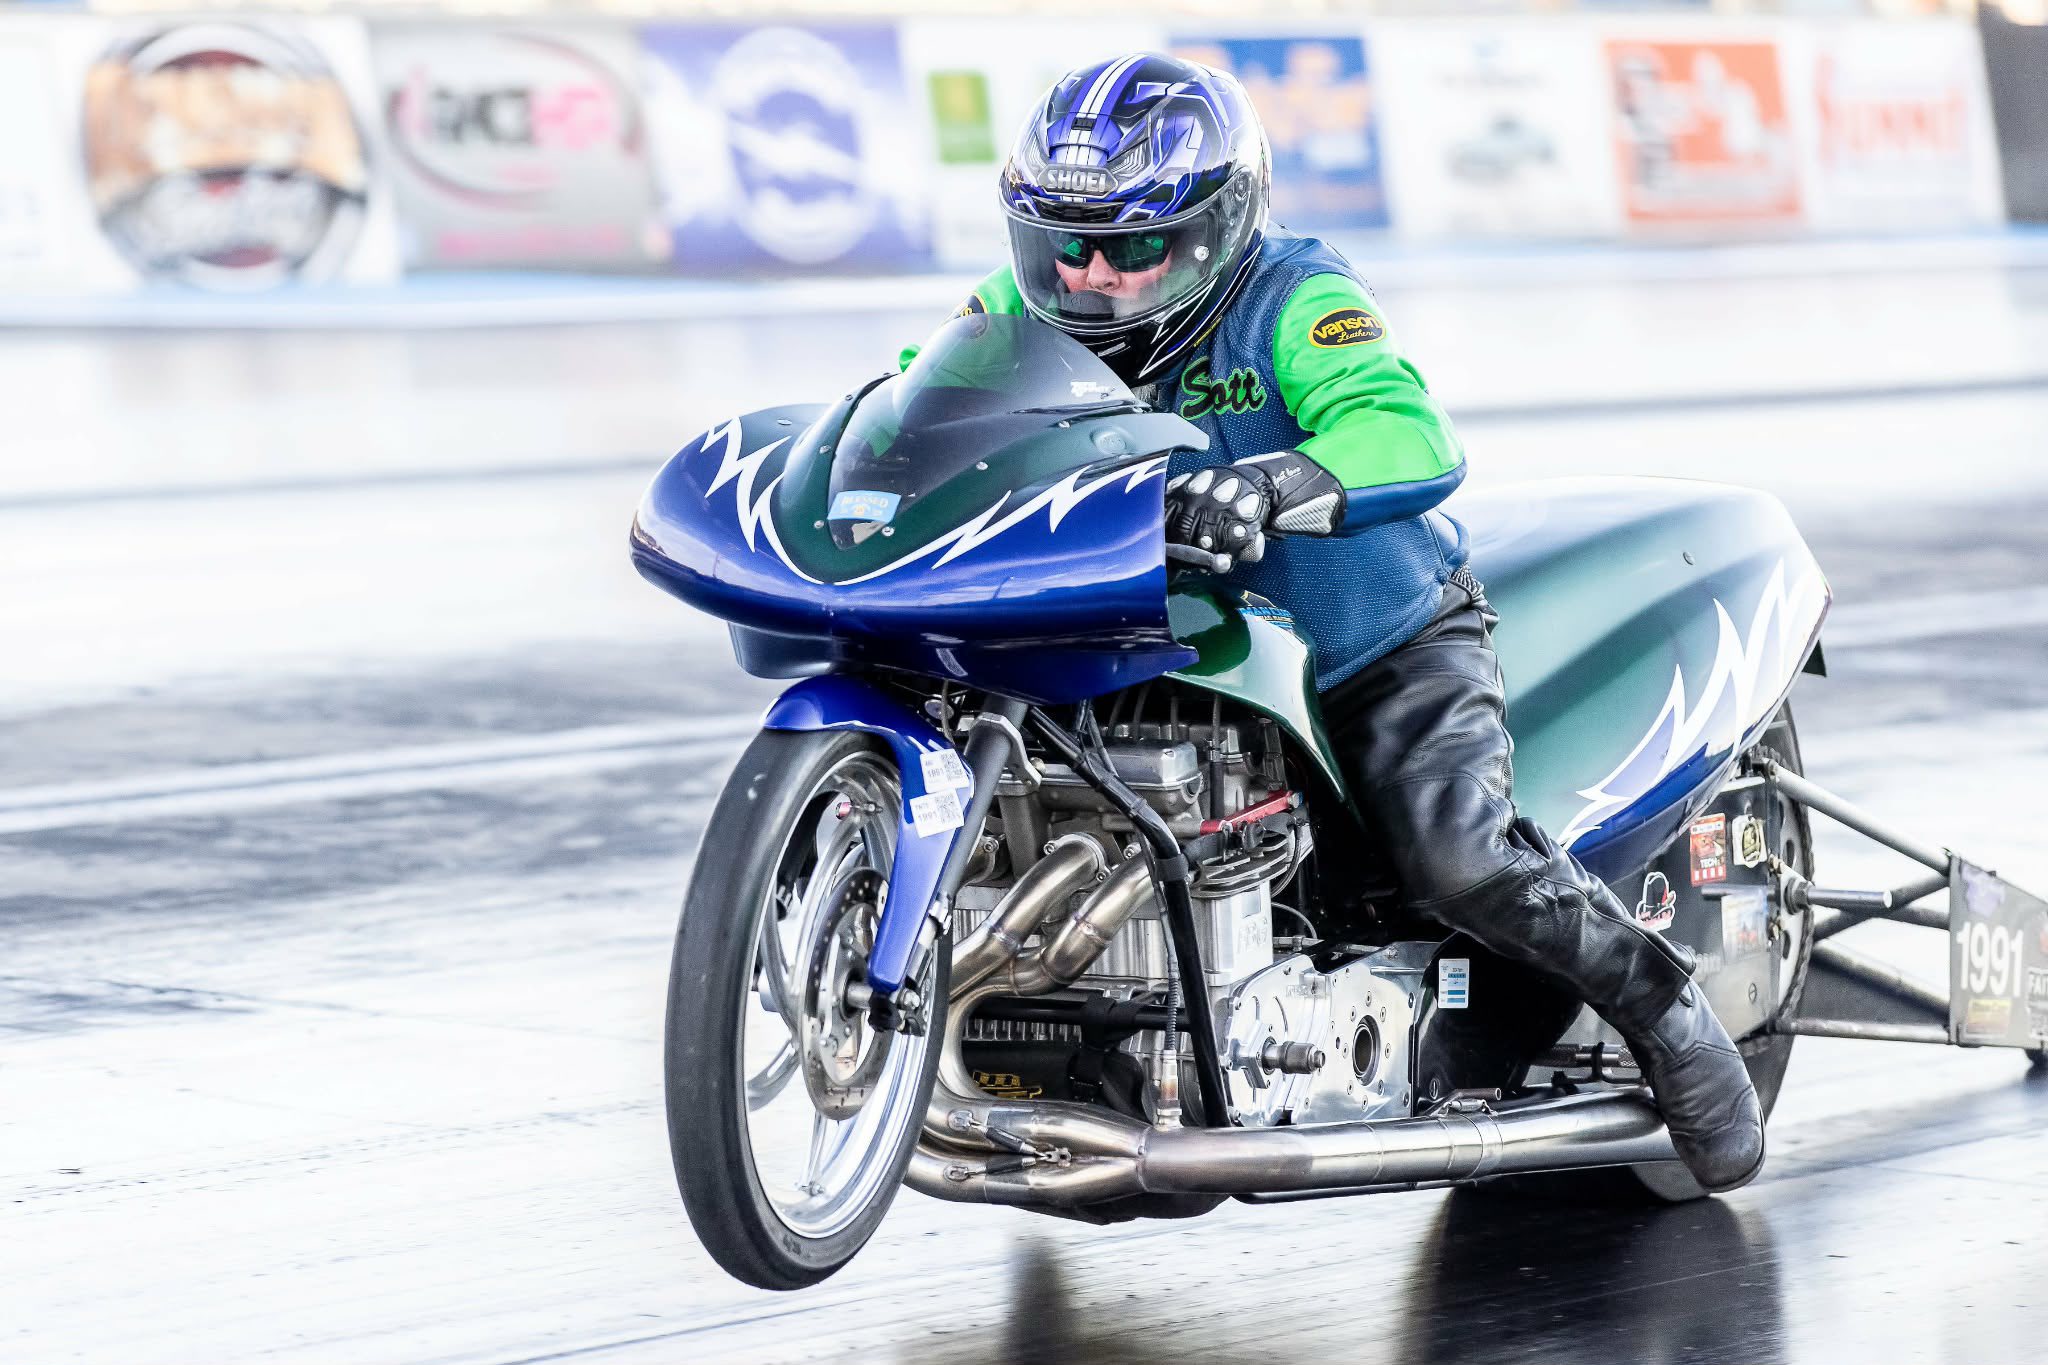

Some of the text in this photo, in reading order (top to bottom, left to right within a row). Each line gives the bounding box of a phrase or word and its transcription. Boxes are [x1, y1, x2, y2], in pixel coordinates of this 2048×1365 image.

[1047, 169, 1106, 192] SHOEI
[1313, 316, 1383, 338] vanson
[1956, 921, 2024, 998] 1991
